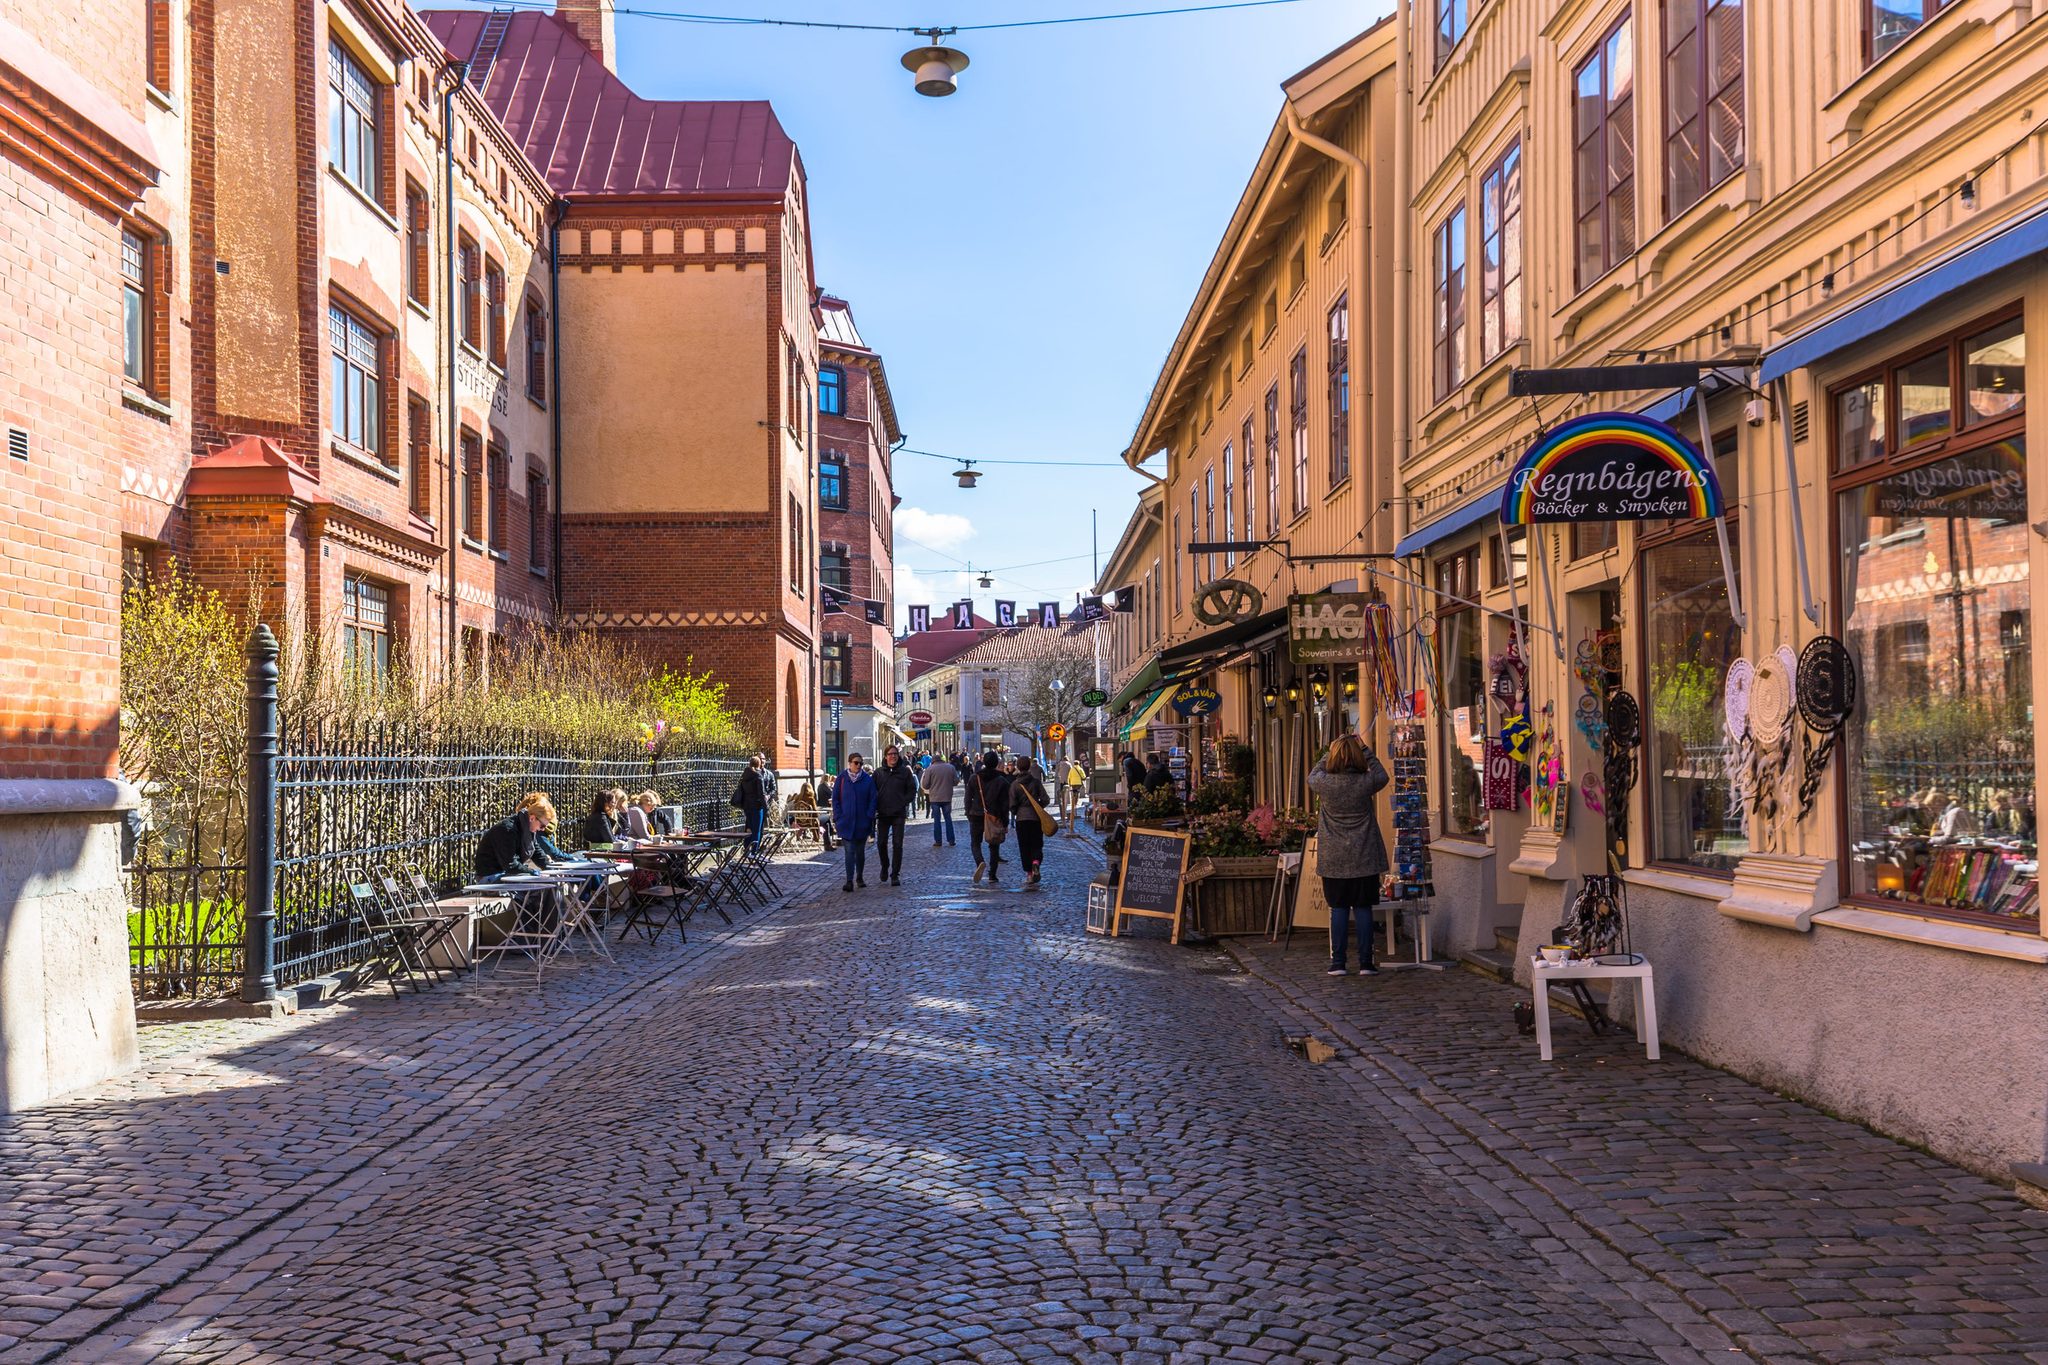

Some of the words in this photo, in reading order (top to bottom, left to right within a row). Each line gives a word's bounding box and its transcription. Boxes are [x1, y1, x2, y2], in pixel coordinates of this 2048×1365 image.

[457, 363, 508, 418] STIFTELSE
[1513, 460, 1710, 501] Regnbågens
[1531, 498, 1589, 517] Böcker
[1597, 501, 1609, 514] &
[1616, 496, 1688, 517] Smycken
[1298, 646, 1343, 658] Souvenirs
[1345, 647, 1352, 656] &
[1176, 690, 1194, 703] SOL
[1193, 689, 1200, 697] &
[1199, 688, 1216, 700] VÅR
